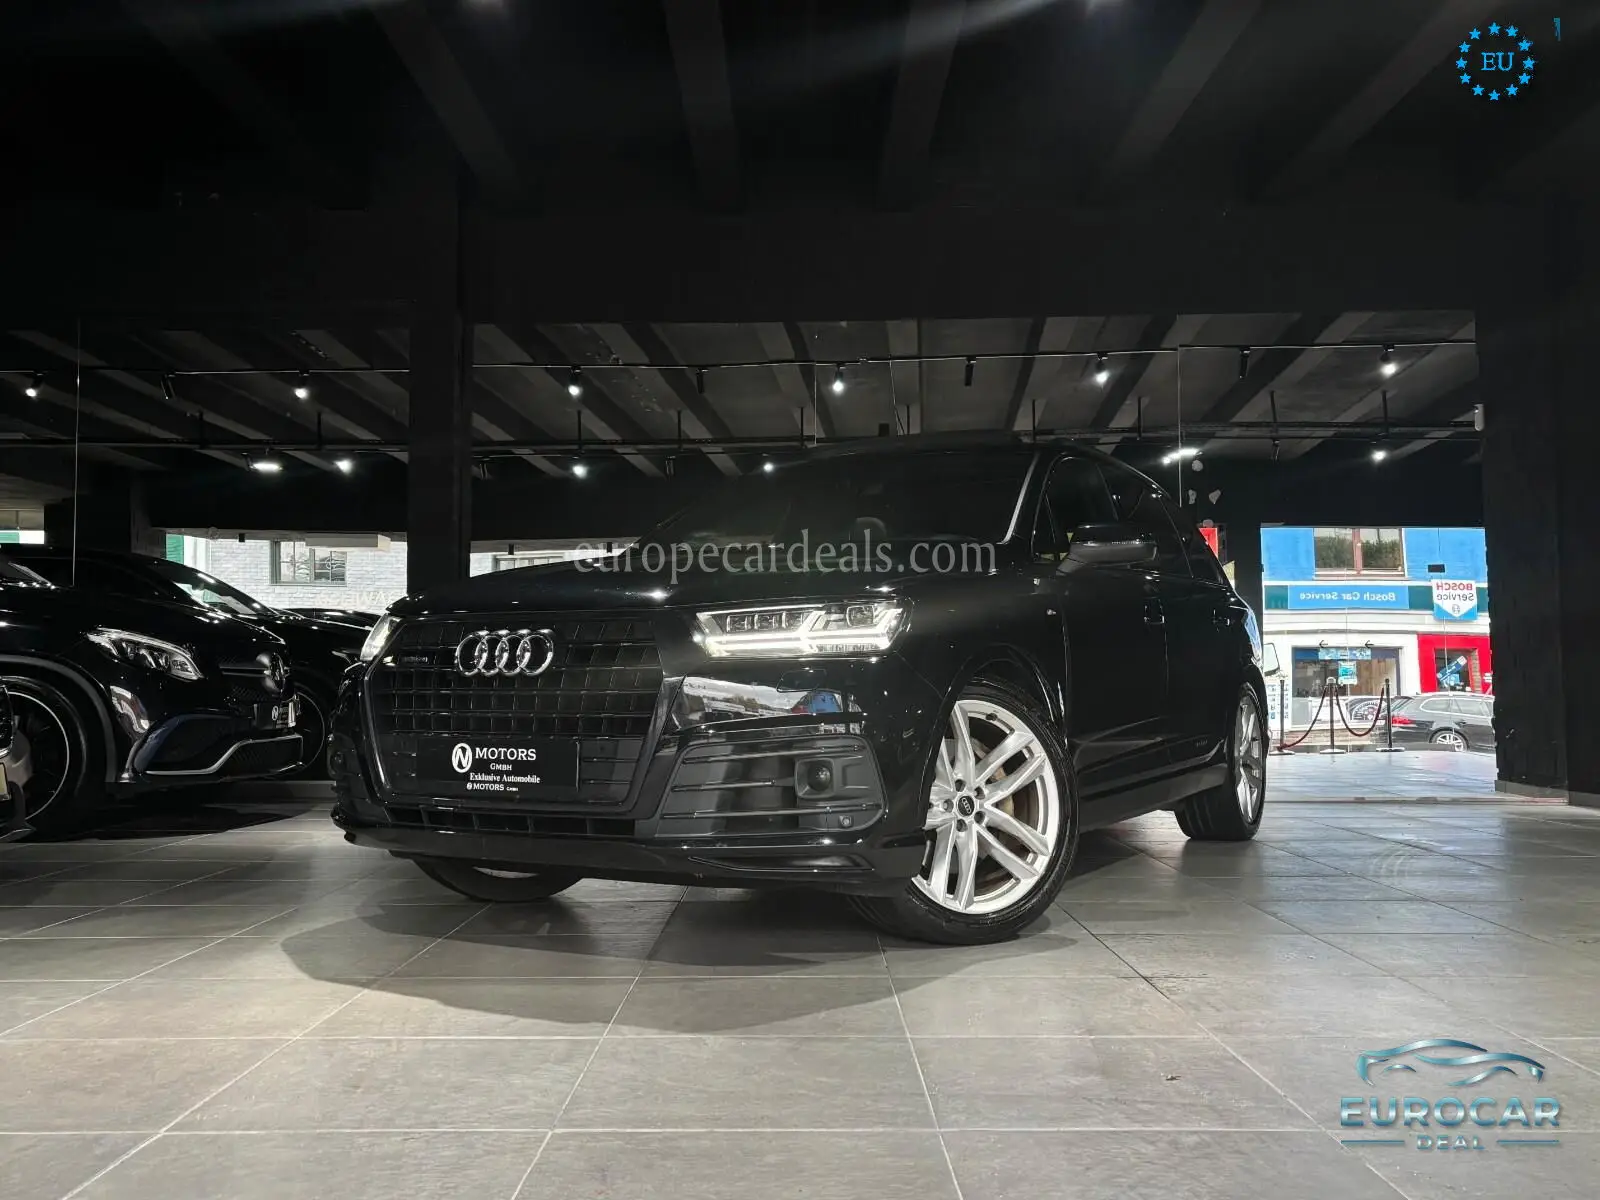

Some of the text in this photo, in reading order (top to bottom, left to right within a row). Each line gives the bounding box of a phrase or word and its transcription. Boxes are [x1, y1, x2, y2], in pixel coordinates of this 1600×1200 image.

[475, 747, 537, 761] MOTORS
[490, 763, 513, 771] GMBH
[469, 772, 541, 784] Exklusive Automobile
[473, 782, 505, 791] MOTORS
